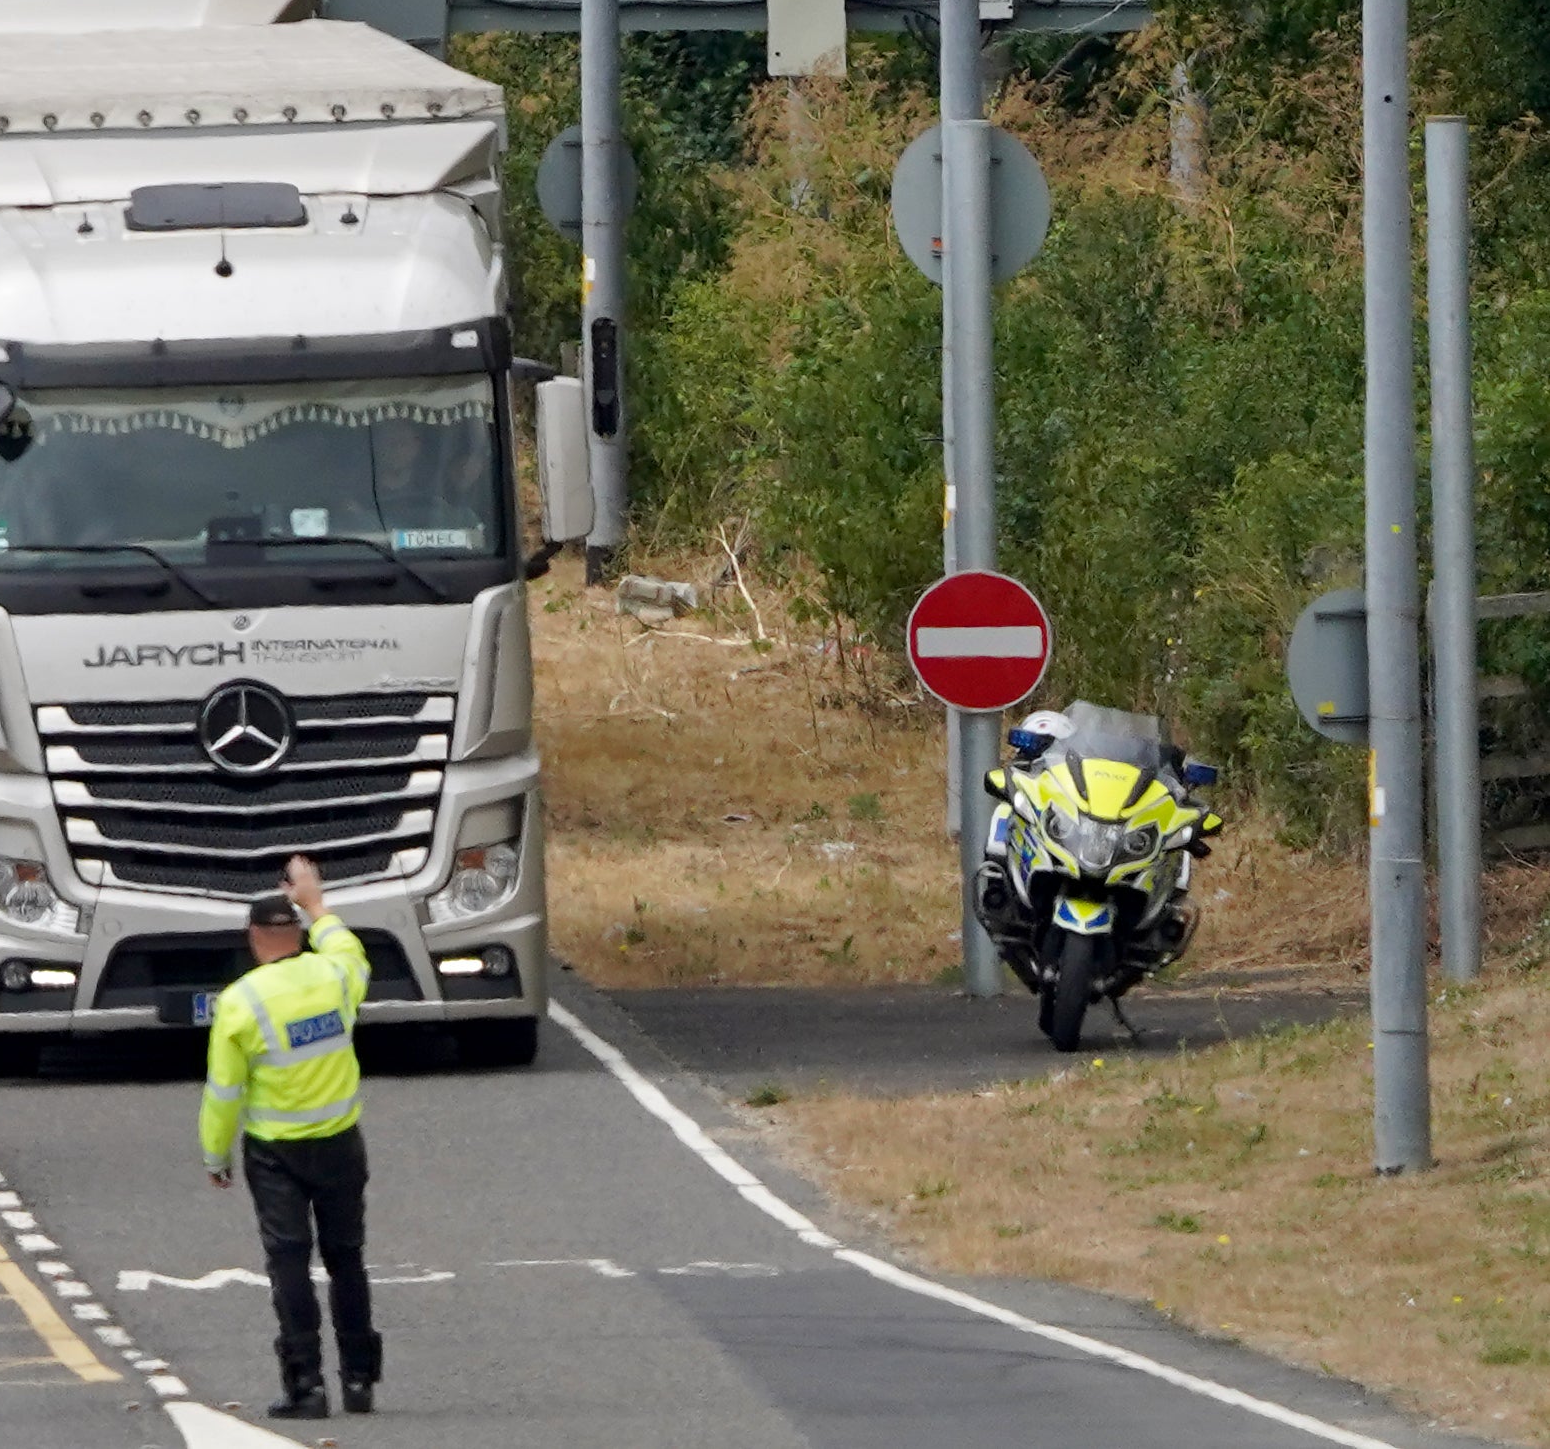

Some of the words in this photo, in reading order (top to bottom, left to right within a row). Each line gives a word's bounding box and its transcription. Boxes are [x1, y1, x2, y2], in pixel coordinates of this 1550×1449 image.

[83, 641, 246, 667] JARYCH
[251, 638, 401, 651] INTERNATIONAL
[289, 1013, 342, 1043] POLICE
